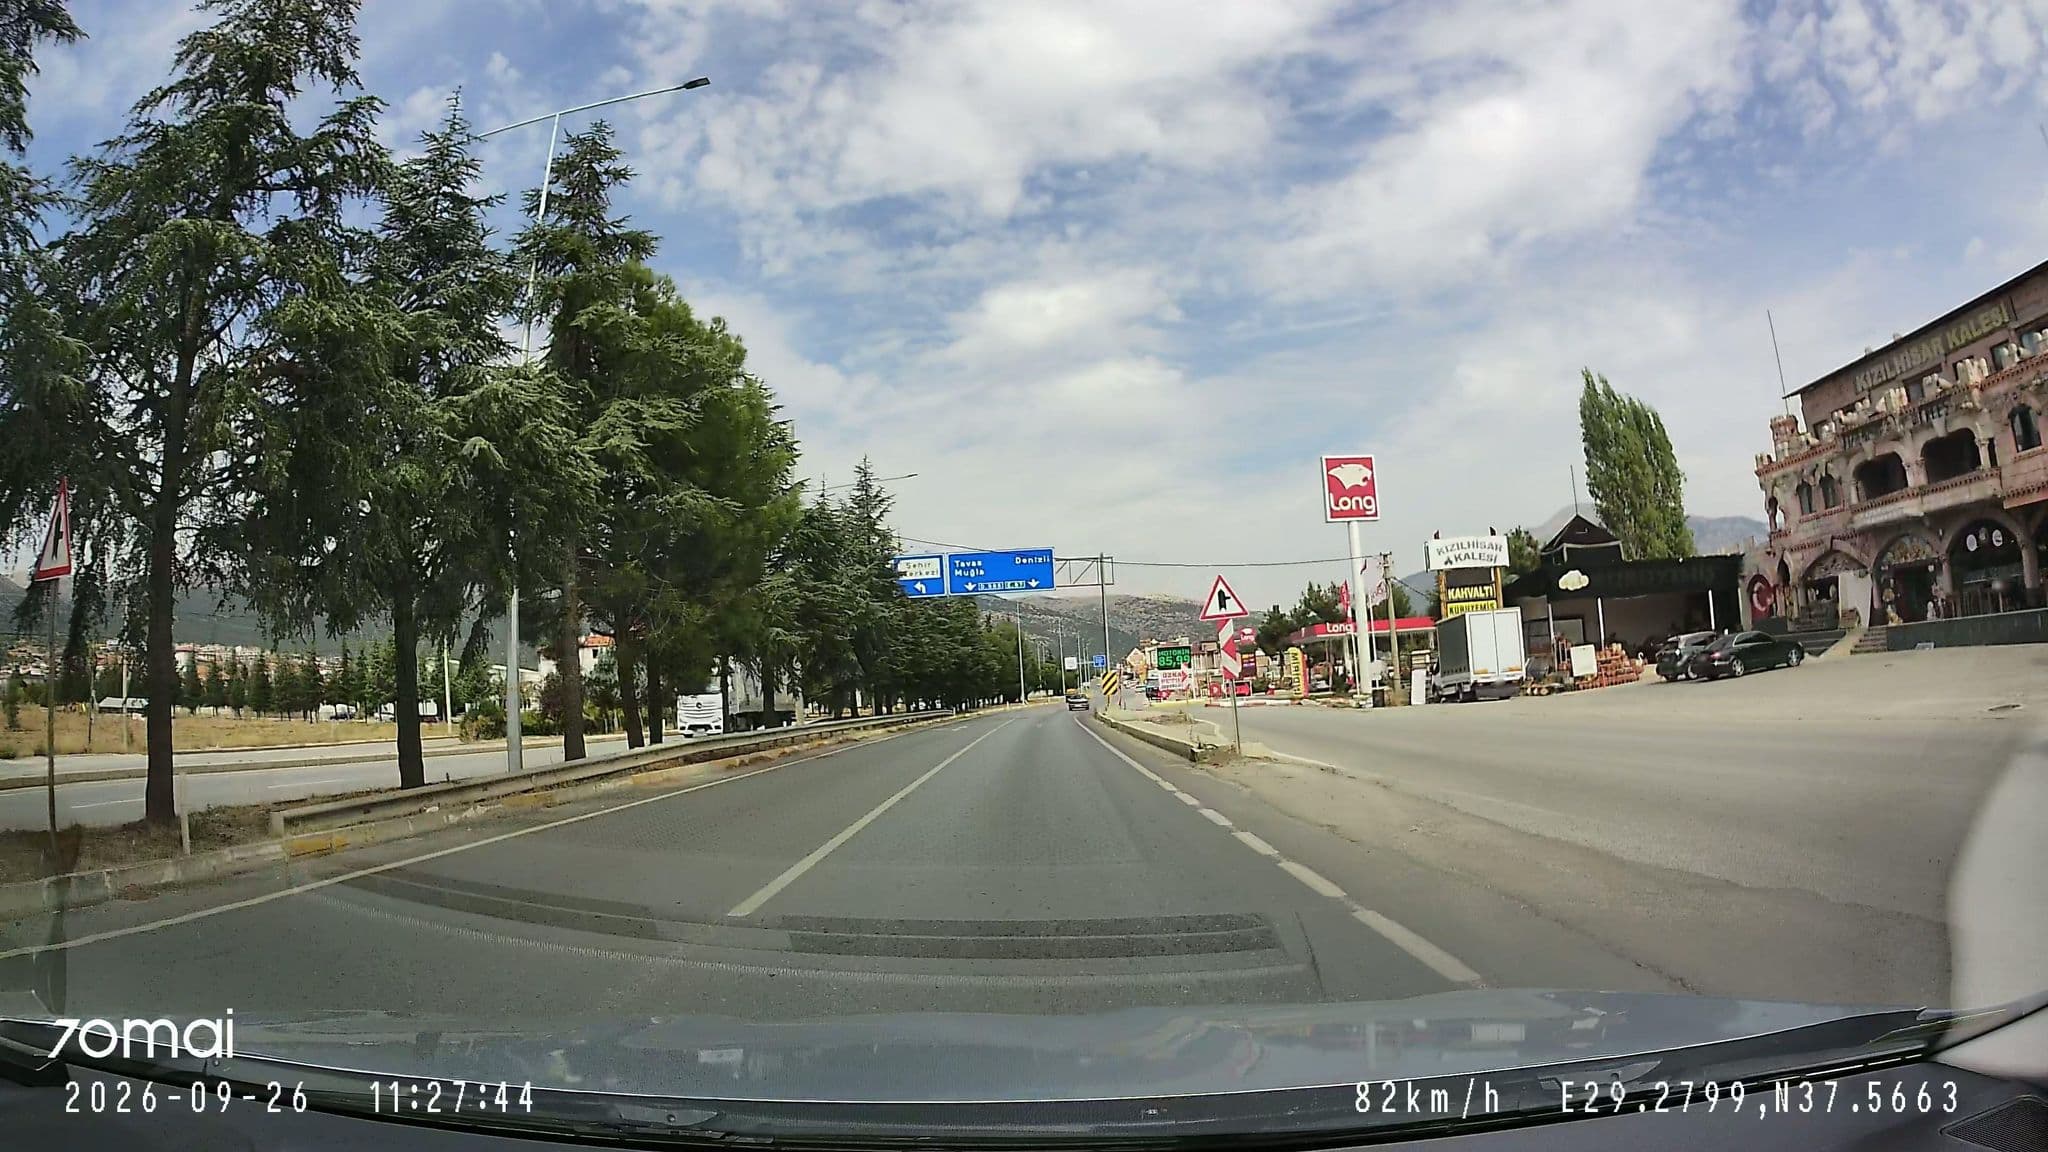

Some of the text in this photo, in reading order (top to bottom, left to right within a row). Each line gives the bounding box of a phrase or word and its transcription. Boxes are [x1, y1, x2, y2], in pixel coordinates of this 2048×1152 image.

[1015, 555, 1050, 564] Denizli
[954, 568, 984, 577] Muğla
[1448, 586, 1493, 600] KAHVALTI
